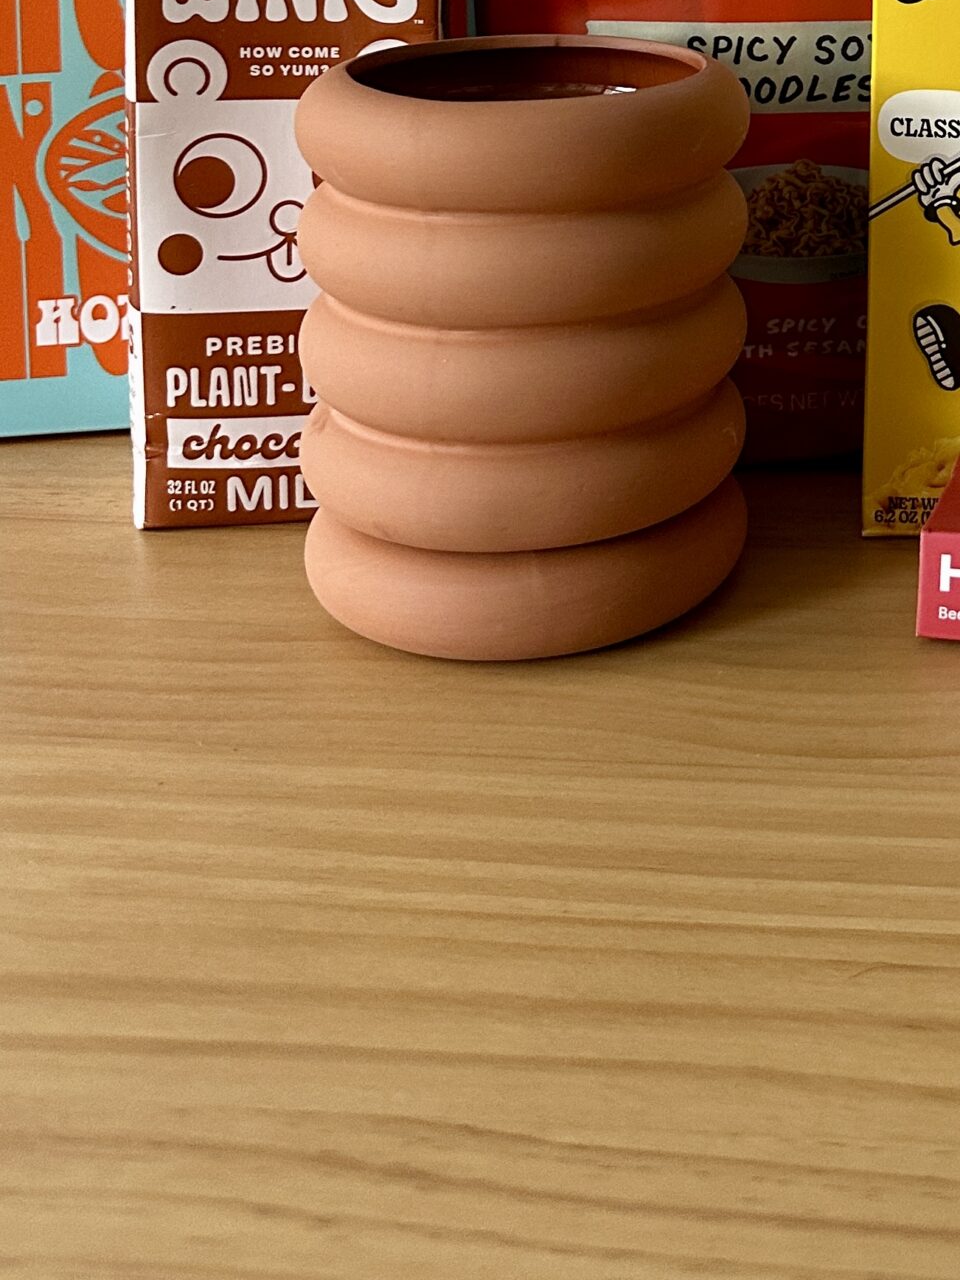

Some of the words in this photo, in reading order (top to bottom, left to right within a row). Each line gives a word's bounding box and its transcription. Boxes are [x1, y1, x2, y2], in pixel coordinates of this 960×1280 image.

[240, 46, 282, 59] HOW
[288, 46, 341, 60] COME
[687, 35, 797, 65] SPICY
[814, 34, 872, 65] SO
[250, 64, 274, 77] SO
[280, 64, 330, 77] YUM?
[739, 74, 871, 104] ODLES
[36, 294, 128, 346] HO
[766, 317, 837, 335] SPICY
[167, 480, 182, 495] 32
[185, 480, 198, 495] FL
[200, 480, 216, 495] OZ
[169, 499, 182, 511] (1
[187, 499, 214, 511] QT)
[888, 496, 919, 510] NET
[874, 510, 896, 524] 6.2
[899, 510, 919, 524] OZ
